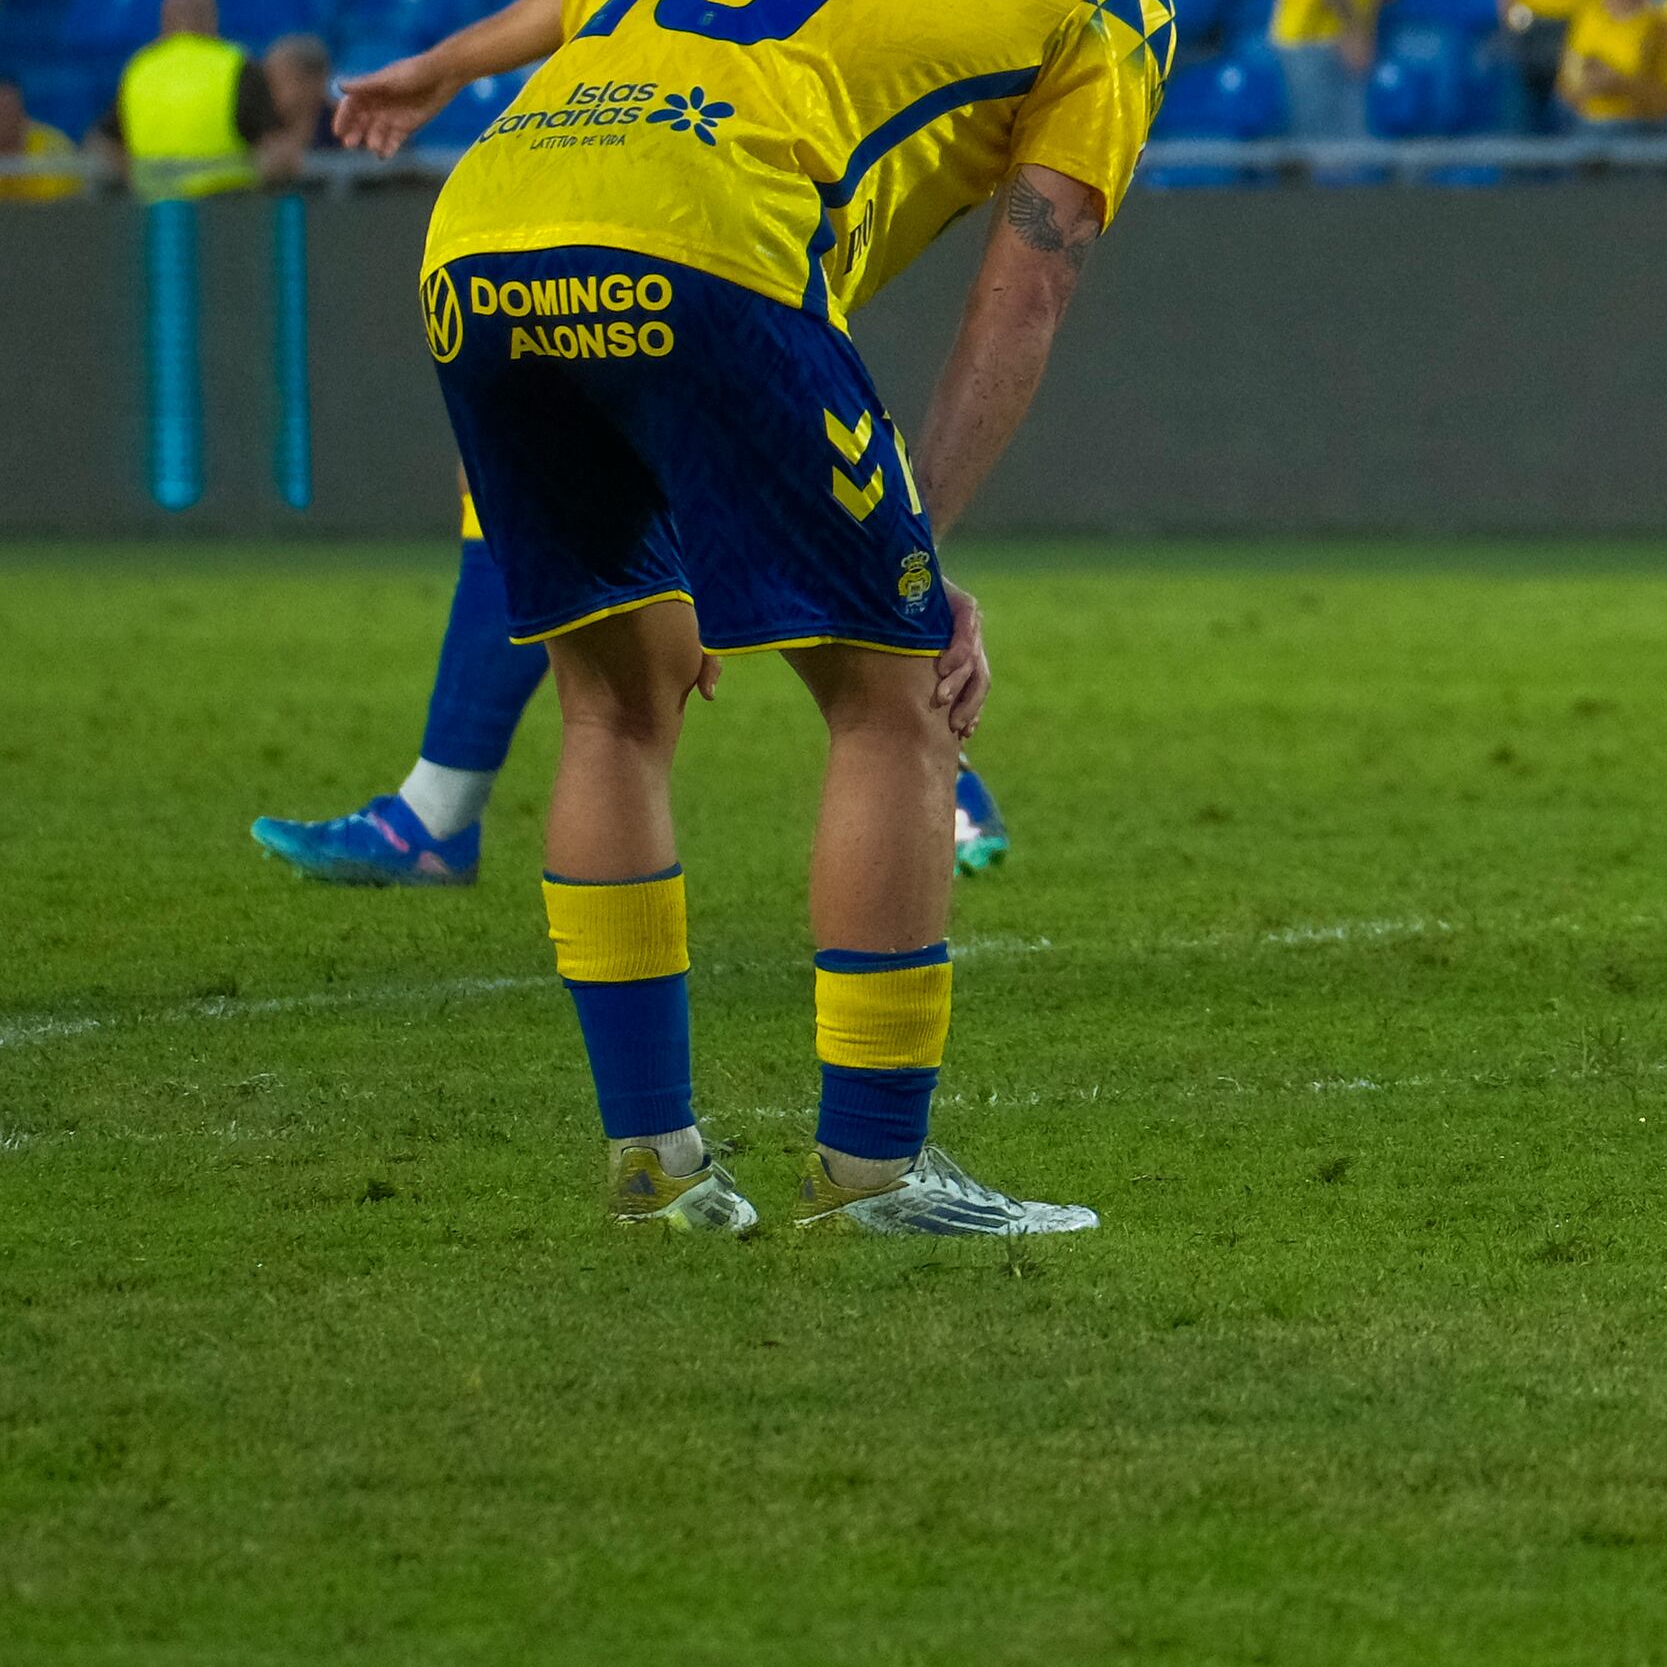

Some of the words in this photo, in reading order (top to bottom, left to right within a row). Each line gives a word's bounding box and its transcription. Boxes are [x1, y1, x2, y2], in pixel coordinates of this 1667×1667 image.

[566, 80, 658, 107] Islas
[581, 135, 596, 147] DE
[599, 134, 626, 147] VIDA
[470, 273, 673, 317] DOMINGO
[510, 320, 675, 360] ALONSO
